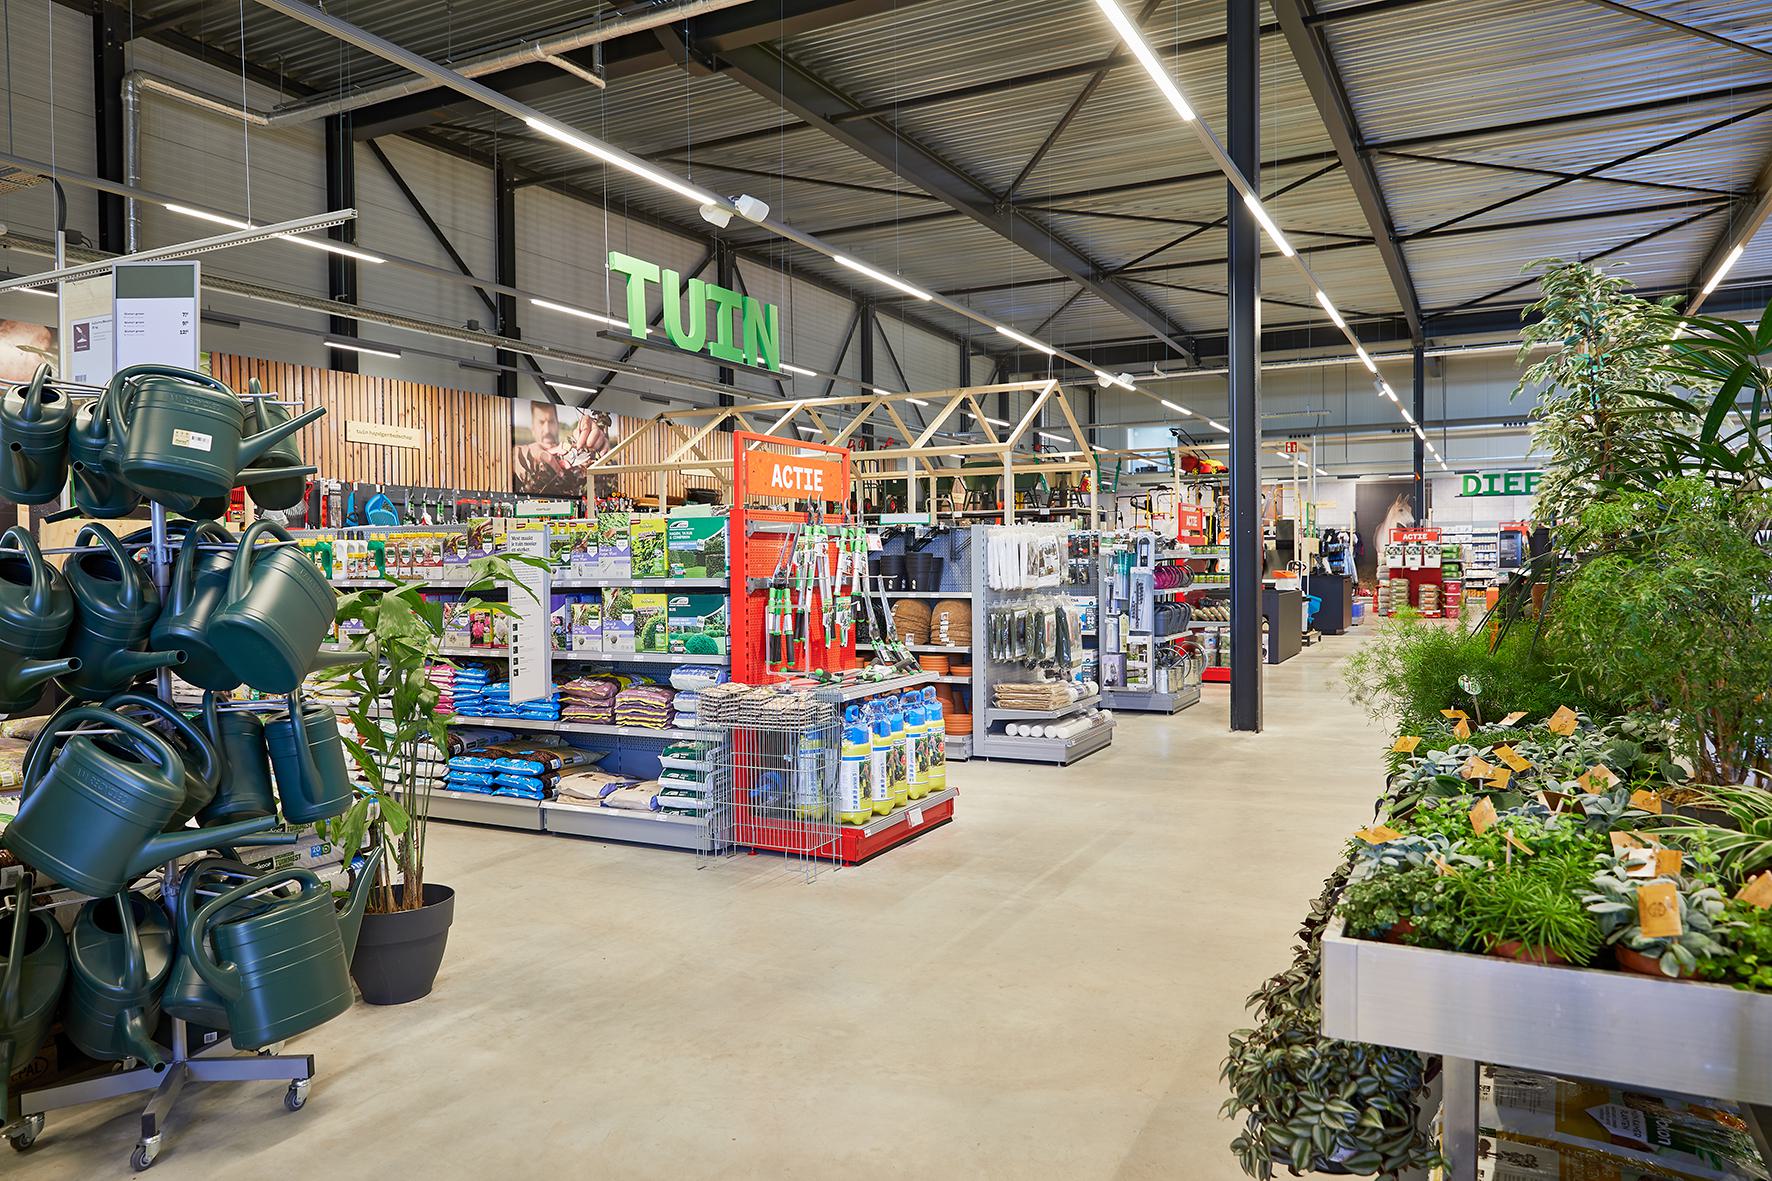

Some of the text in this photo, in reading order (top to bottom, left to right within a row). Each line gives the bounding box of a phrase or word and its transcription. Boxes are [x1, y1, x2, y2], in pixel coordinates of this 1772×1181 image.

[608, 250, 780, 373] TUIN
[771, 463, 824, 492] ACTIE
[312, 845, 320, 853] 20
